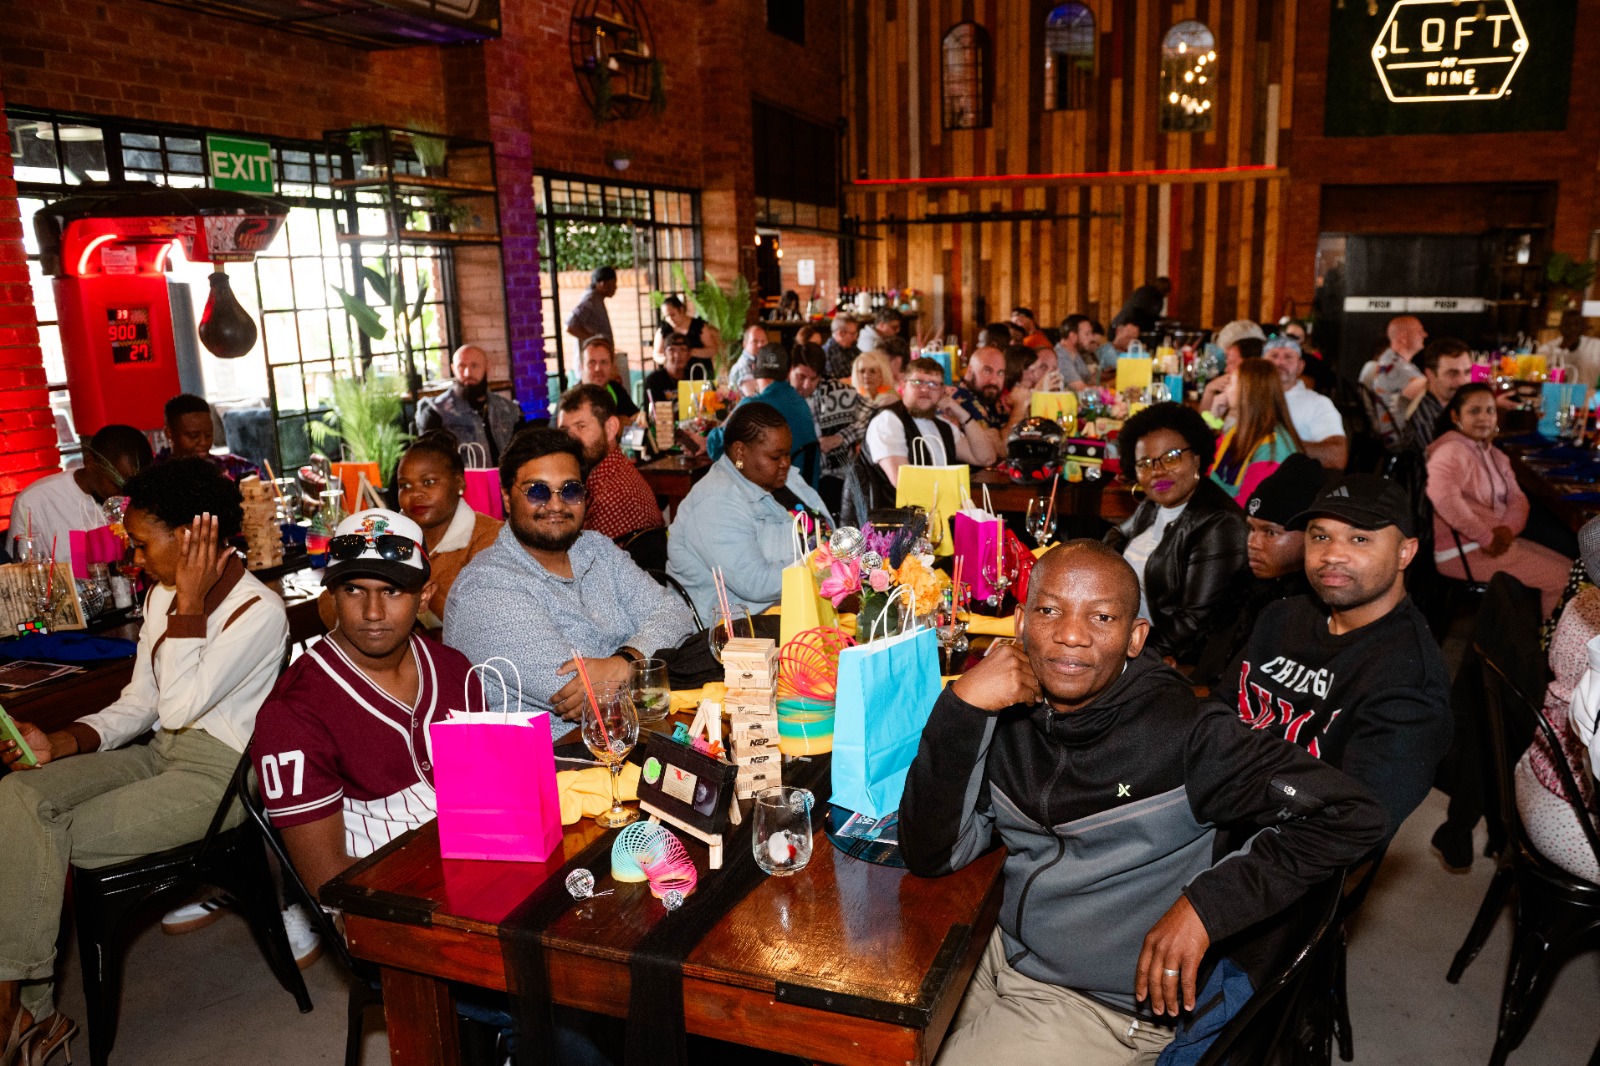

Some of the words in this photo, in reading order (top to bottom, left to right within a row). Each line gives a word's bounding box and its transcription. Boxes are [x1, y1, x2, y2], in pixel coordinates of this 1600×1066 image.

[1390, 14, 1511, 54] LOFT
[1426, 68, 1476, 86] NINE
[212, 151, 269, 182] EXIT
[1368, 300, 1391, 309] PUSH
[1434, 300, 1458, 309] PUSH
[117, 310, 128, 319] 39
[109, 325, 136, 341] 900
[750, 738, 769, 747] NEP
[750, 755, 769, 764] NEP
[261, 749, 305, 800] 07
